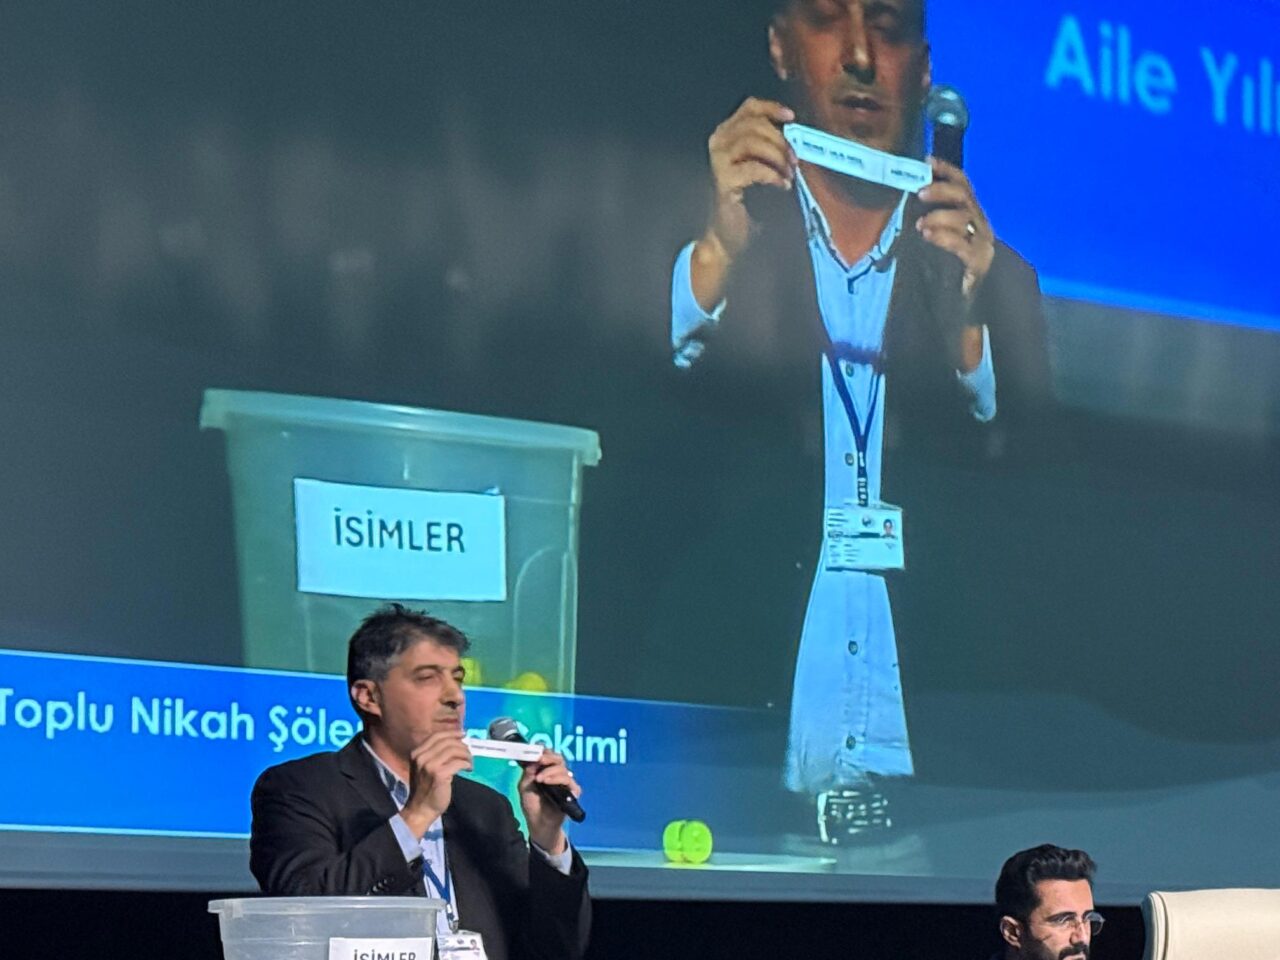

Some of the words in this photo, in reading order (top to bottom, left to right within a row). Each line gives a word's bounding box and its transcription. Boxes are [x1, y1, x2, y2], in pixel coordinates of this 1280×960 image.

[1045, 15, 1177, 115] Aile
[333, 507, 466, 553] İSİMLER
[131, 696, 255, 741] Nikah
